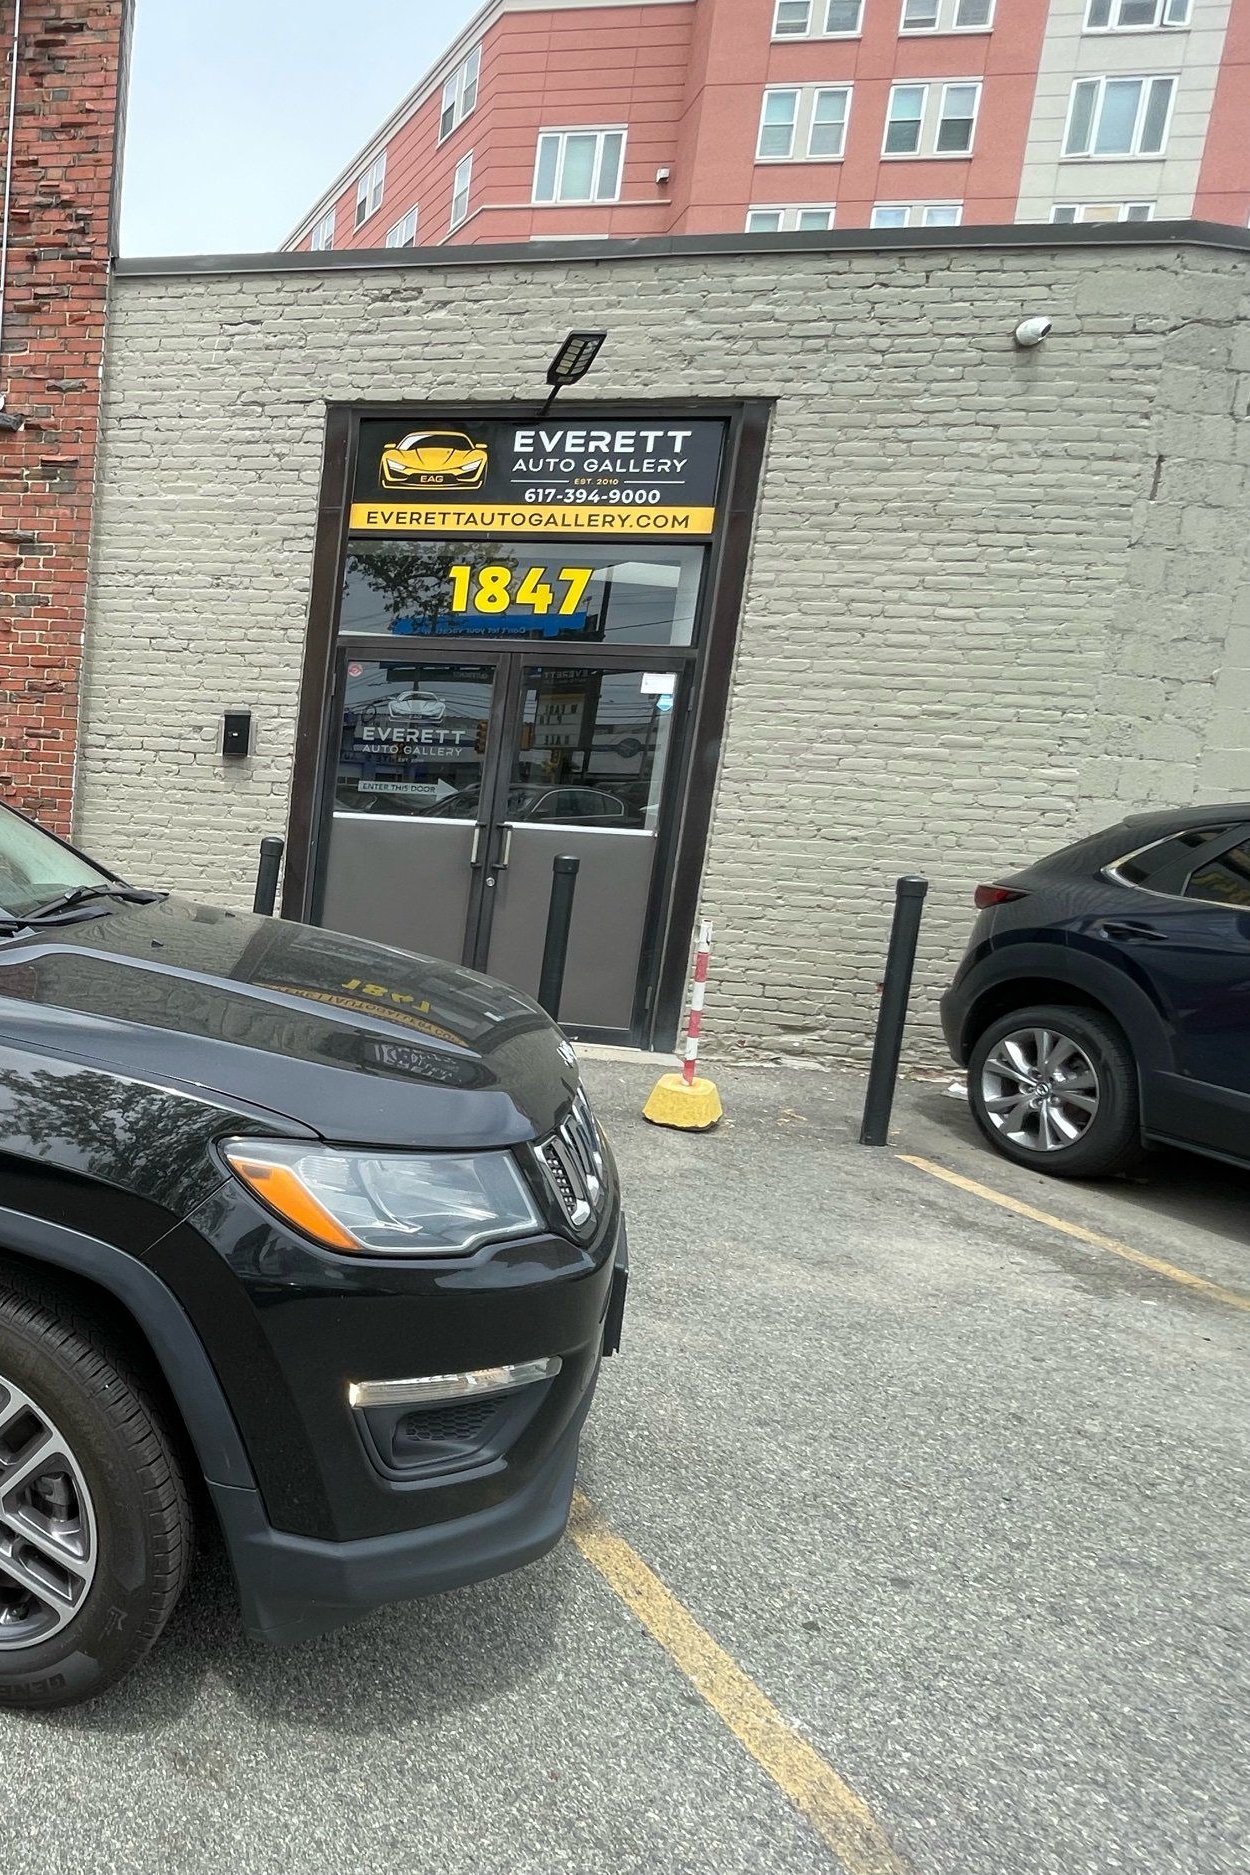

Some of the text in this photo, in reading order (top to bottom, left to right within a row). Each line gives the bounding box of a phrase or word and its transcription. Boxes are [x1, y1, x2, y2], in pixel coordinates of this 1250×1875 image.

[513, 430, 692, 453] EVERETT
[512, 458, 688, 473] AUTO GALLERY
[420, 474, 444, 484] EAG
[524, 488, 661, 504] 617-394-9000
[366, 511, 690, 529] EVERETTAUTOGALLERY.COM
[449, 563, 593, 616] 1847
[362, 726, 466, 744] EVERETT
[362, 745, 463, 756] AUTO GALLERY
[410, 785, 436, 793] DOOR
